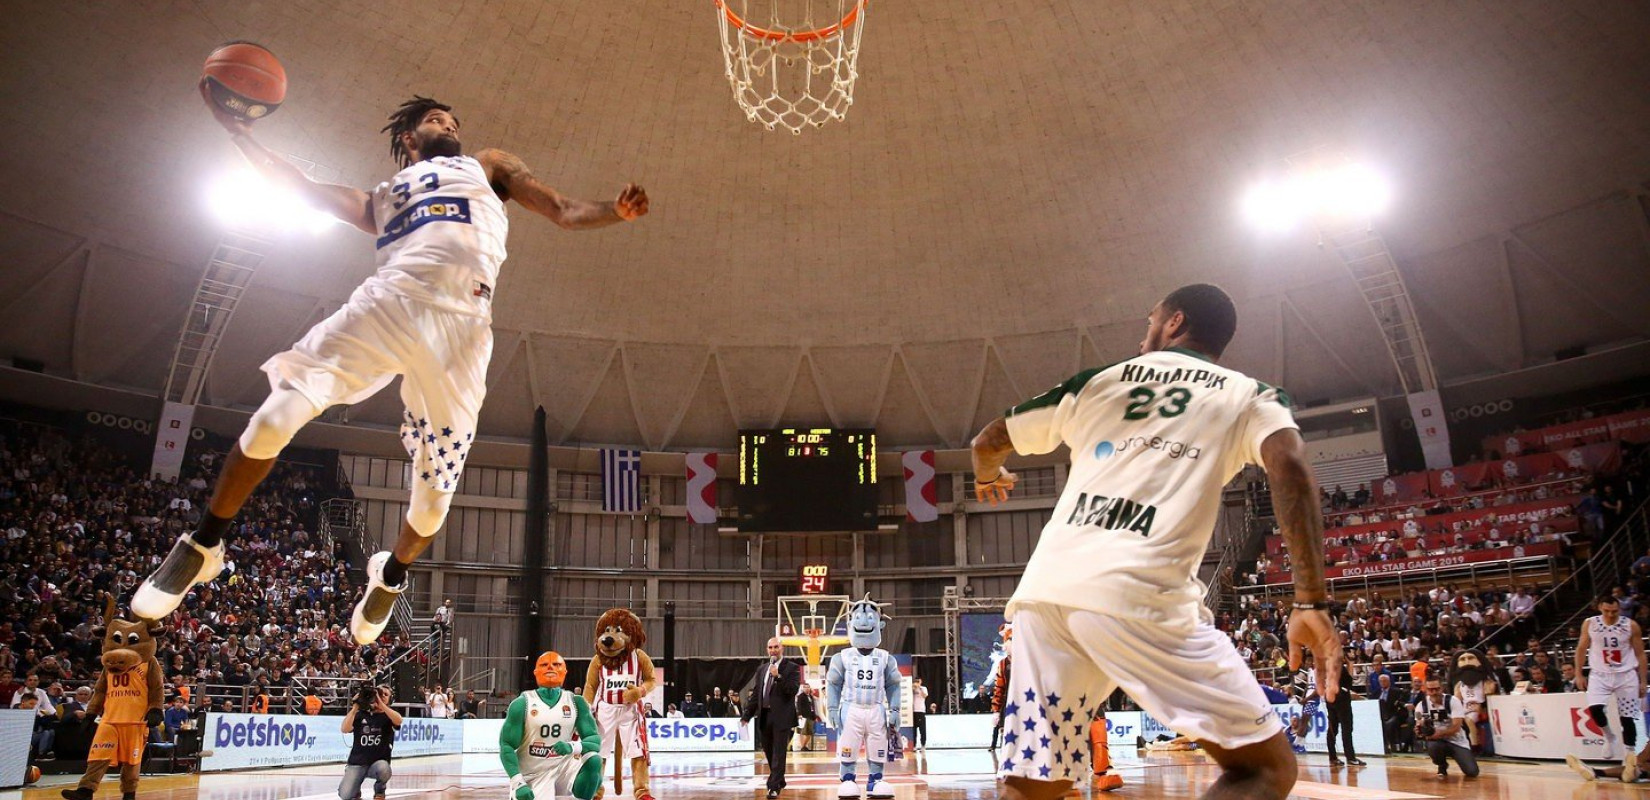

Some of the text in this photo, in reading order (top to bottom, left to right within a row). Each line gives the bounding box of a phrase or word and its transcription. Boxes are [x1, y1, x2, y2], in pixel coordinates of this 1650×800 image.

[1123, 387, 1192, 420] 23
[1343, 556, 1464, 576] EKO ALL STAR GAME 2019
[802, 577, 825, 592] 24
[1603, 636, 1618, 647] 13
[857, 669, 873, 681] 63
[215, 715, 316, 751] betshop.gr
[540, 724, 561, 738] 08
[360, 735, 382, 746] 056
